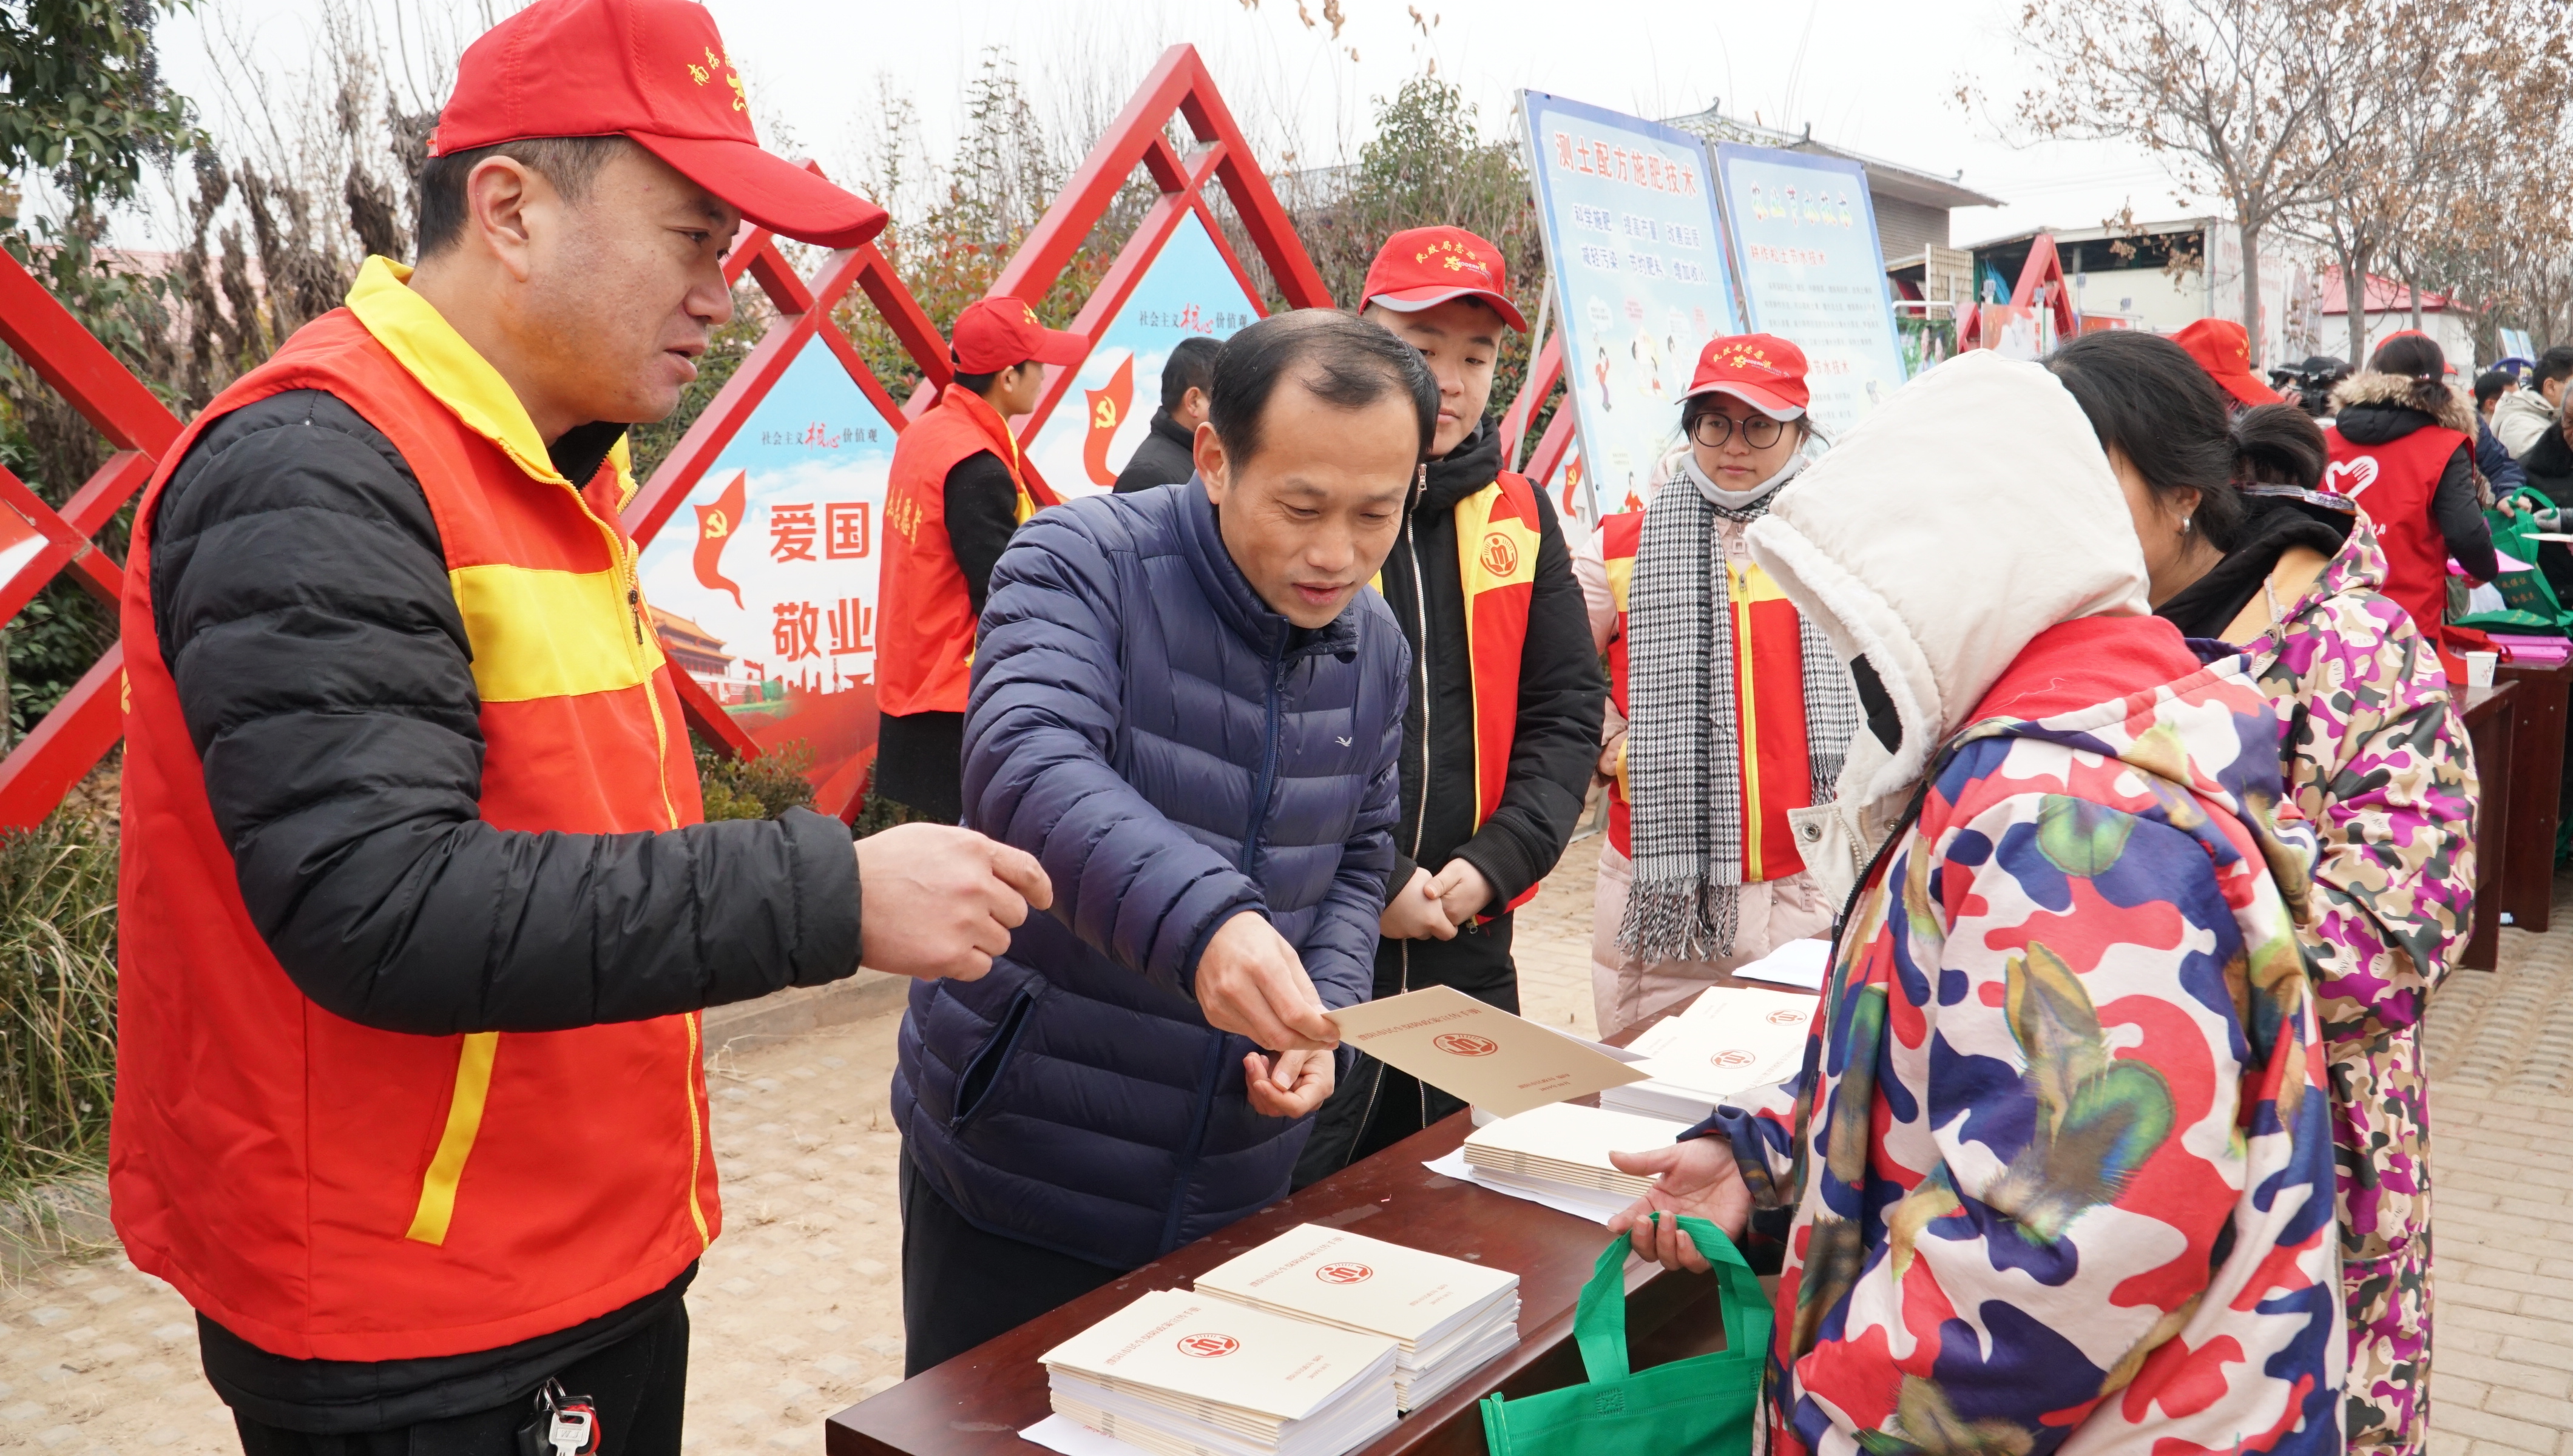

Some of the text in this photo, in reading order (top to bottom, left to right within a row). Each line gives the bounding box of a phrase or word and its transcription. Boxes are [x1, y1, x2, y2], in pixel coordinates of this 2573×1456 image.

[1555, 133, 1697, 197] 测土配方施肥技术
[1574, 205, 1700, 248] 科学施肥 提高产量 改善品质
[1581, 245, 1708, 283] 减轻污染 节约肥料 增加收入
[1139, 303, 1248, 334] 社会主义核心价值观
[762, 421, 879, 451] 社会主义核心价值观
[770, 502, 871, 564] 爱国
[772, 597, 874, 663] 敬业
